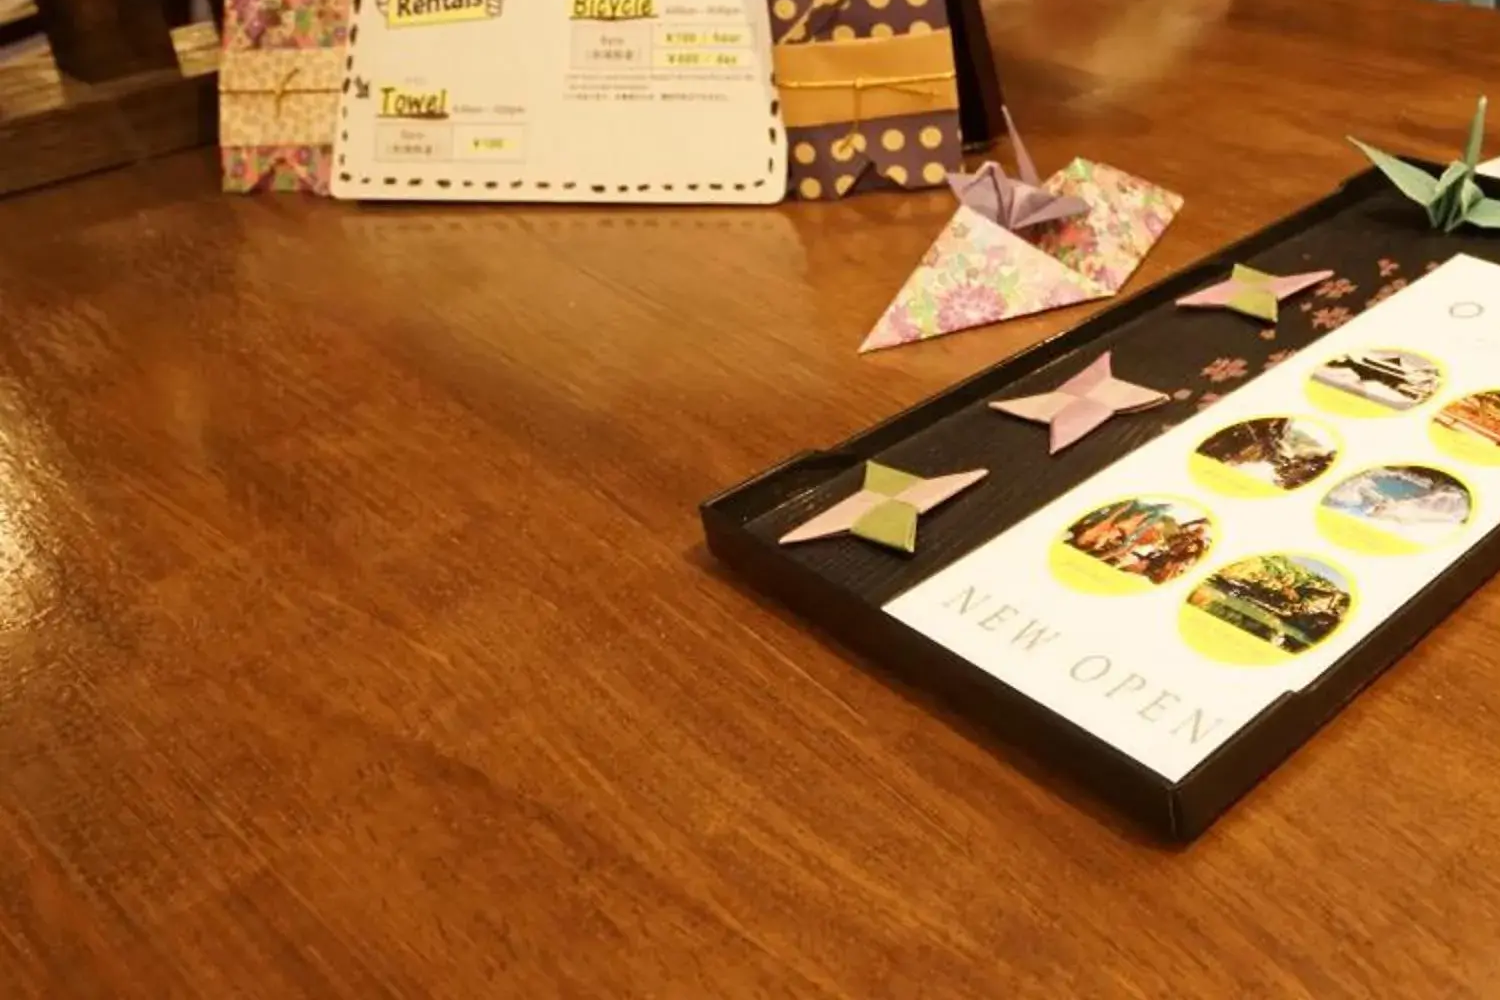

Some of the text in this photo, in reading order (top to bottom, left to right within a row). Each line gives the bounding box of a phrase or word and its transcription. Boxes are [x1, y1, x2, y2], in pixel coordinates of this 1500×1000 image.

[380, 86, 447, 116] Towel
[940, 584, 1225, 746] NEW OPEN
